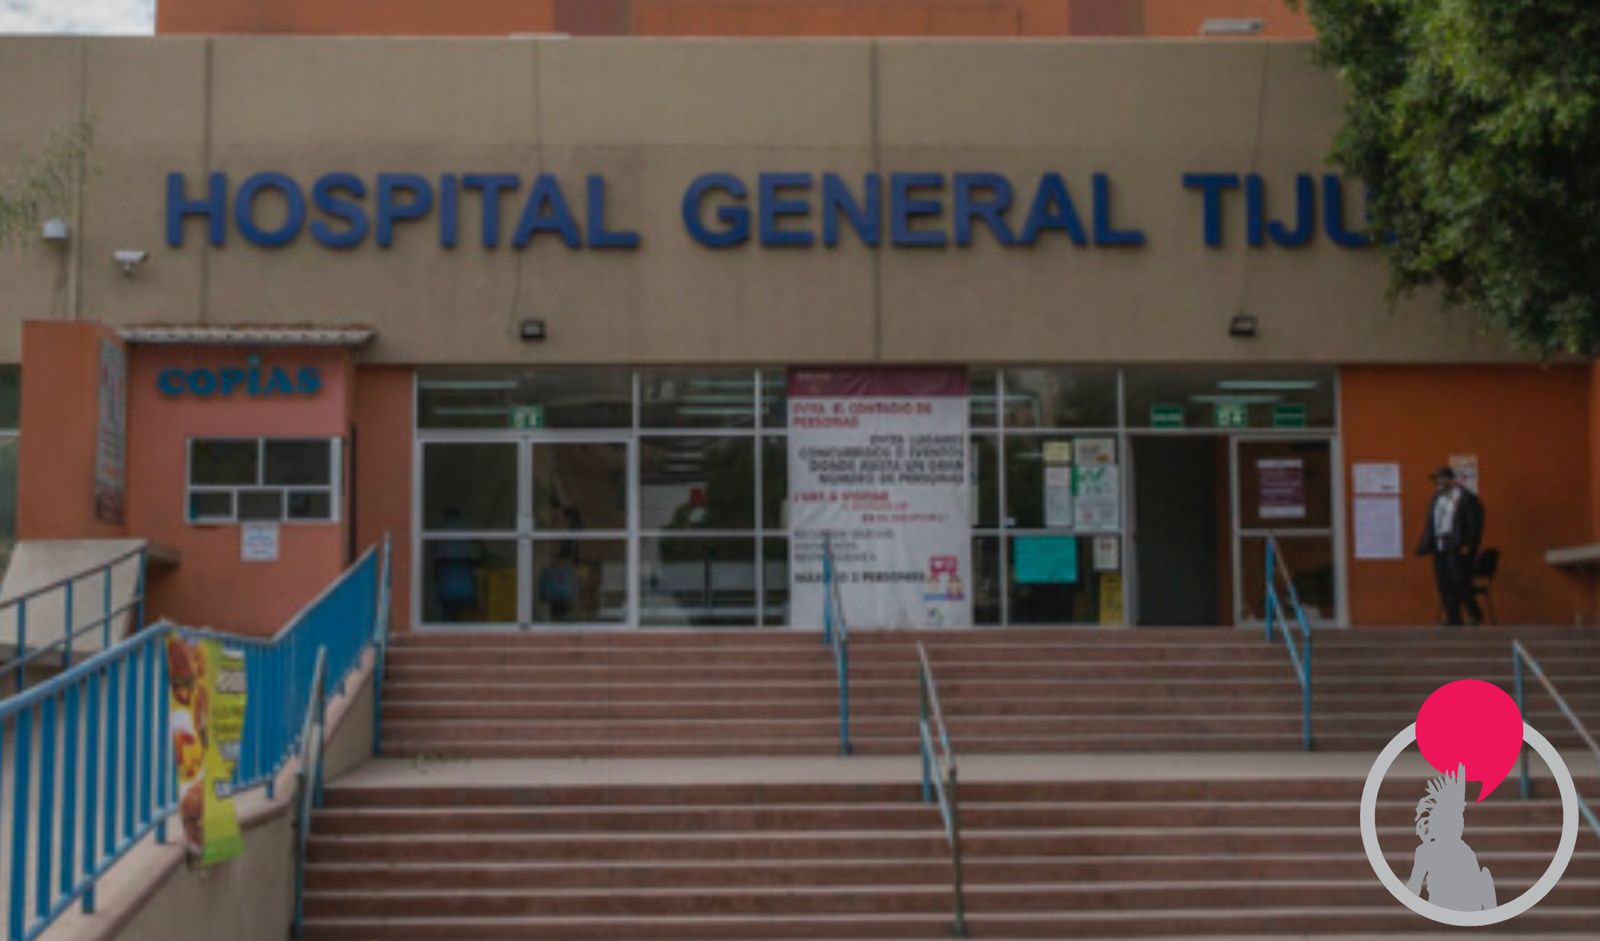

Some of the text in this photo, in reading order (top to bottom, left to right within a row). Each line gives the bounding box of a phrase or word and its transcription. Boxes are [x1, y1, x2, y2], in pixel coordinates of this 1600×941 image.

[166, 172, 1397, 248] HOSPITAL GENERAL TIJU
[916, 402, 933, 414] DE
